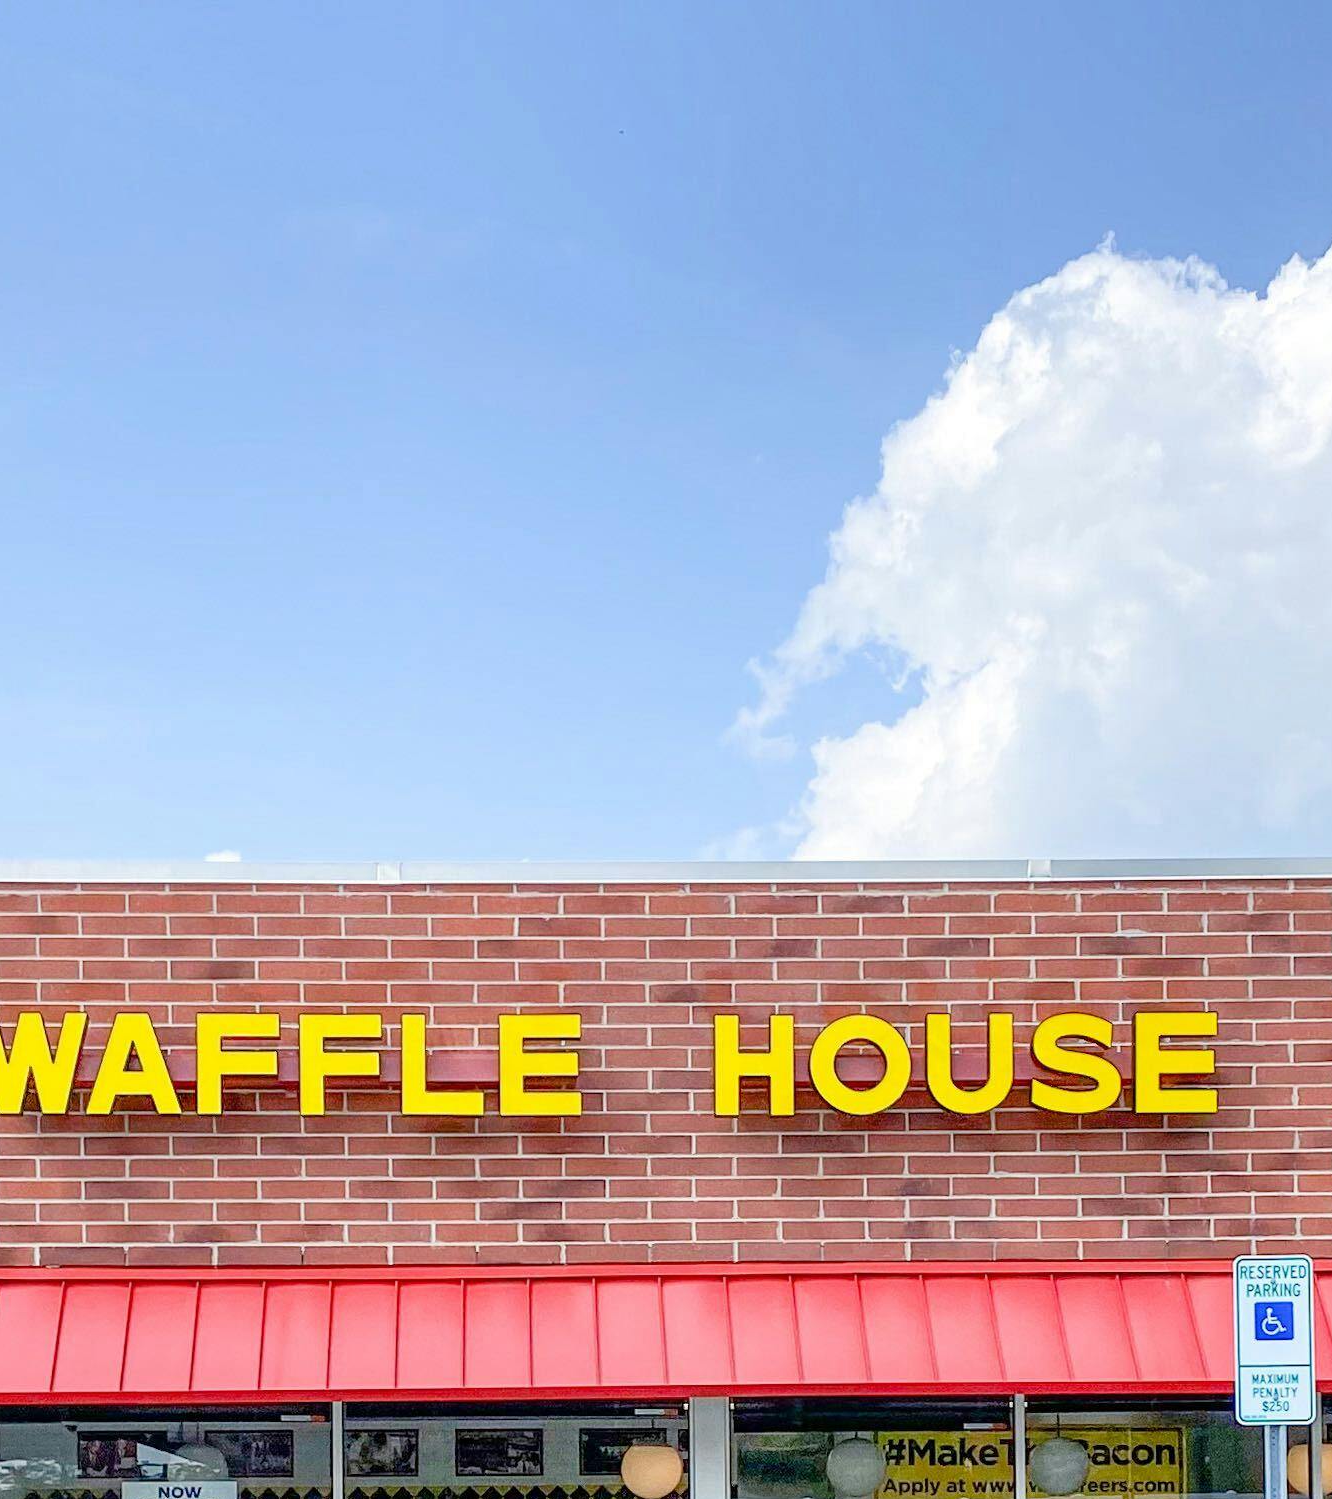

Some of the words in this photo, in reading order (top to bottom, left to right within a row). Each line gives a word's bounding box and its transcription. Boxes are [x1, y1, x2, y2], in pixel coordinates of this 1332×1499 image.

[713, 1011, 1219, 1117] HOUSE
[1240, 1265, 1307, 1280] RESERVED
[1246, 1283, 1301, 1297] PARKING
[1251, 1374, 1299, 1384] MAXIMUM
[1252, 1387, 1298, 1398] PENALTY
[1262, 1401, 1290, 1412] $250
[885, 1438, 1177, 1466] #MakeTacon
[158, 1486, 203, 1499] NOW
[883, 1478, 940, 1495] Apply
[946, 1479, 967, 1493] at
